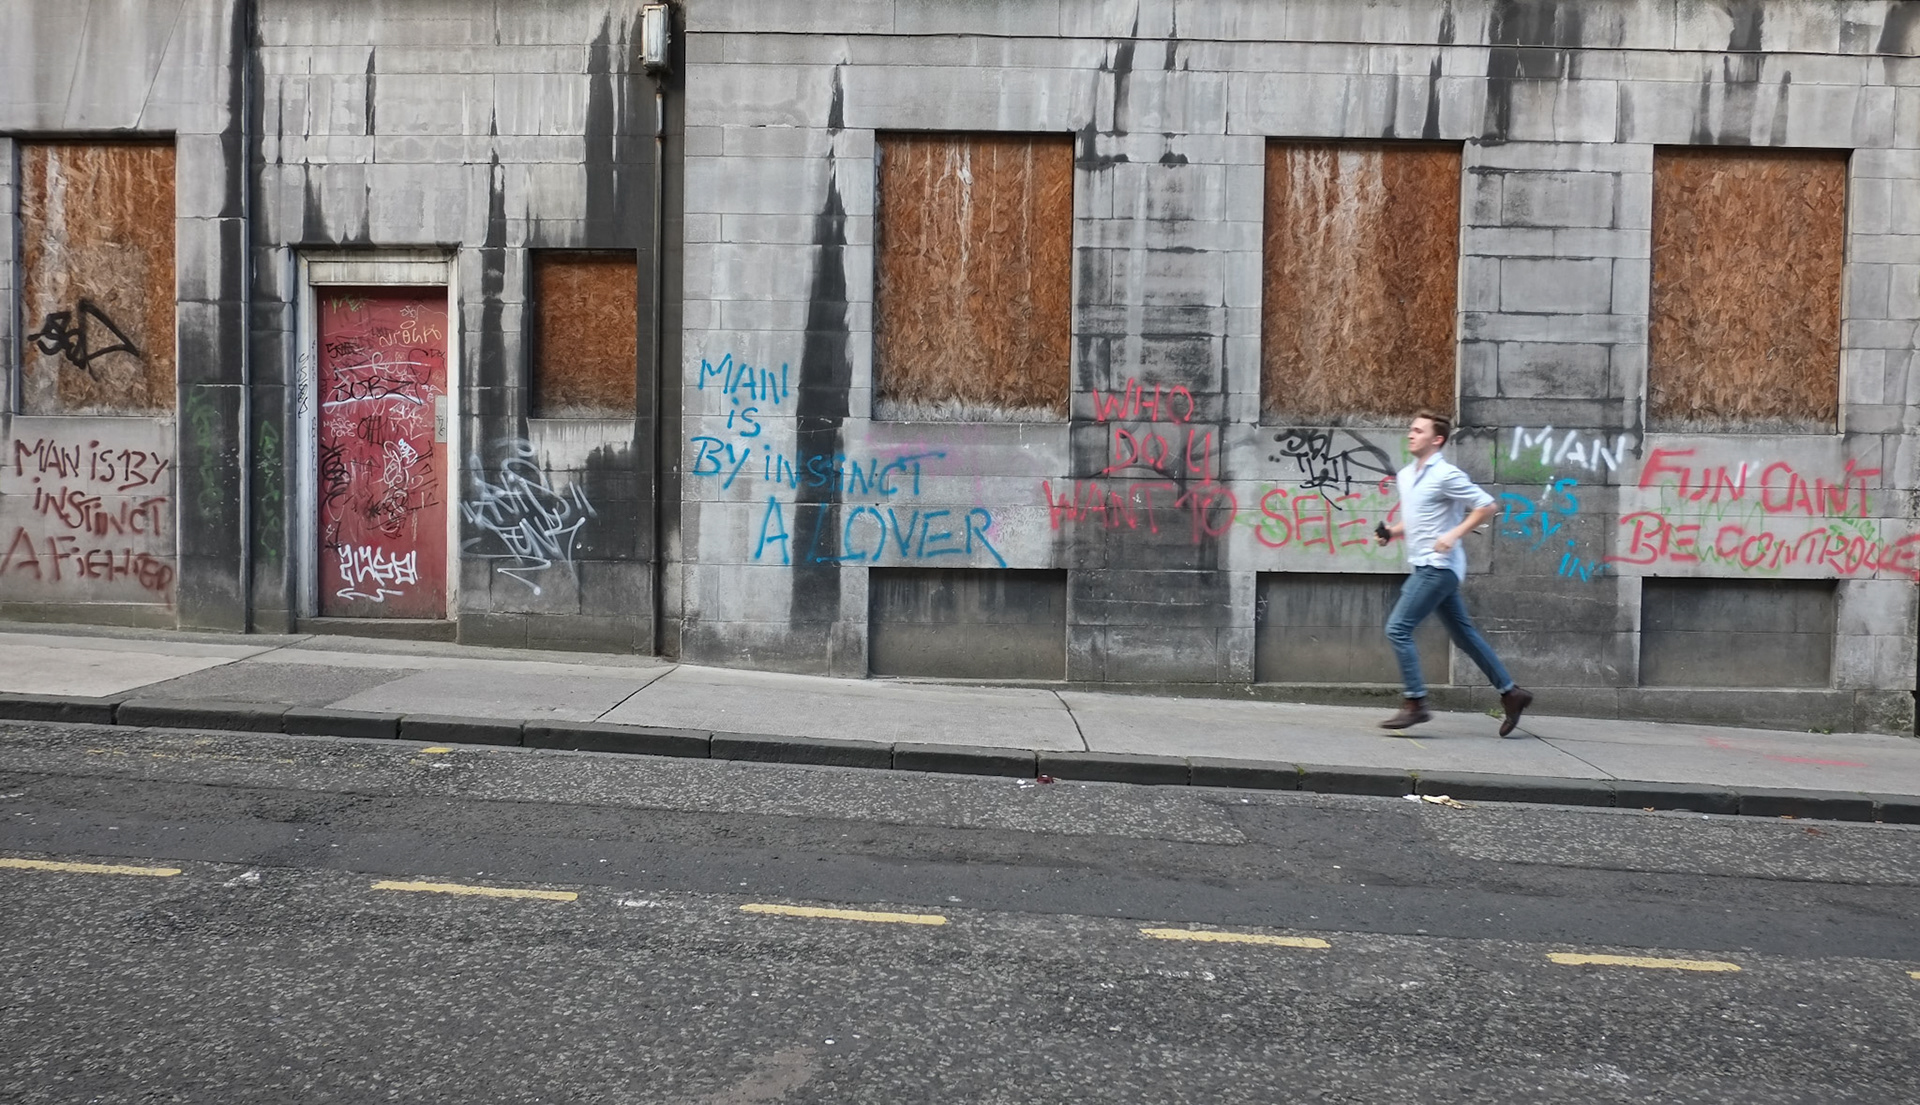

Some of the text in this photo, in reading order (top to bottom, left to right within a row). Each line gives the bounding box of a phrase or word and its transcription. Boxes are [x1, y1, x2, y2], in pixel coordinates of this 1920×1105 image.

[699, 353, 788, 405] MAN
[1093, 377, 1194, 424] WHO
[726, 397, 760, 437] iS
[14, 438, 80, 478] MAN
[89, 440, 115, 482] iS
[691, 436, 750, 490] BY
[1103, 428, 1168, 474] DO
[1510, 424, 1626, 472] MAN
[1639, 448, 1748, 504] FUN
[754, 496, 1007, 568] A LOVER
[1043, 480, 1174, 534] WANT
[1174, 487, 1238, 544] TO
[1602, 510, 1701, 565] BE
[0, 526, 42, 581] A
